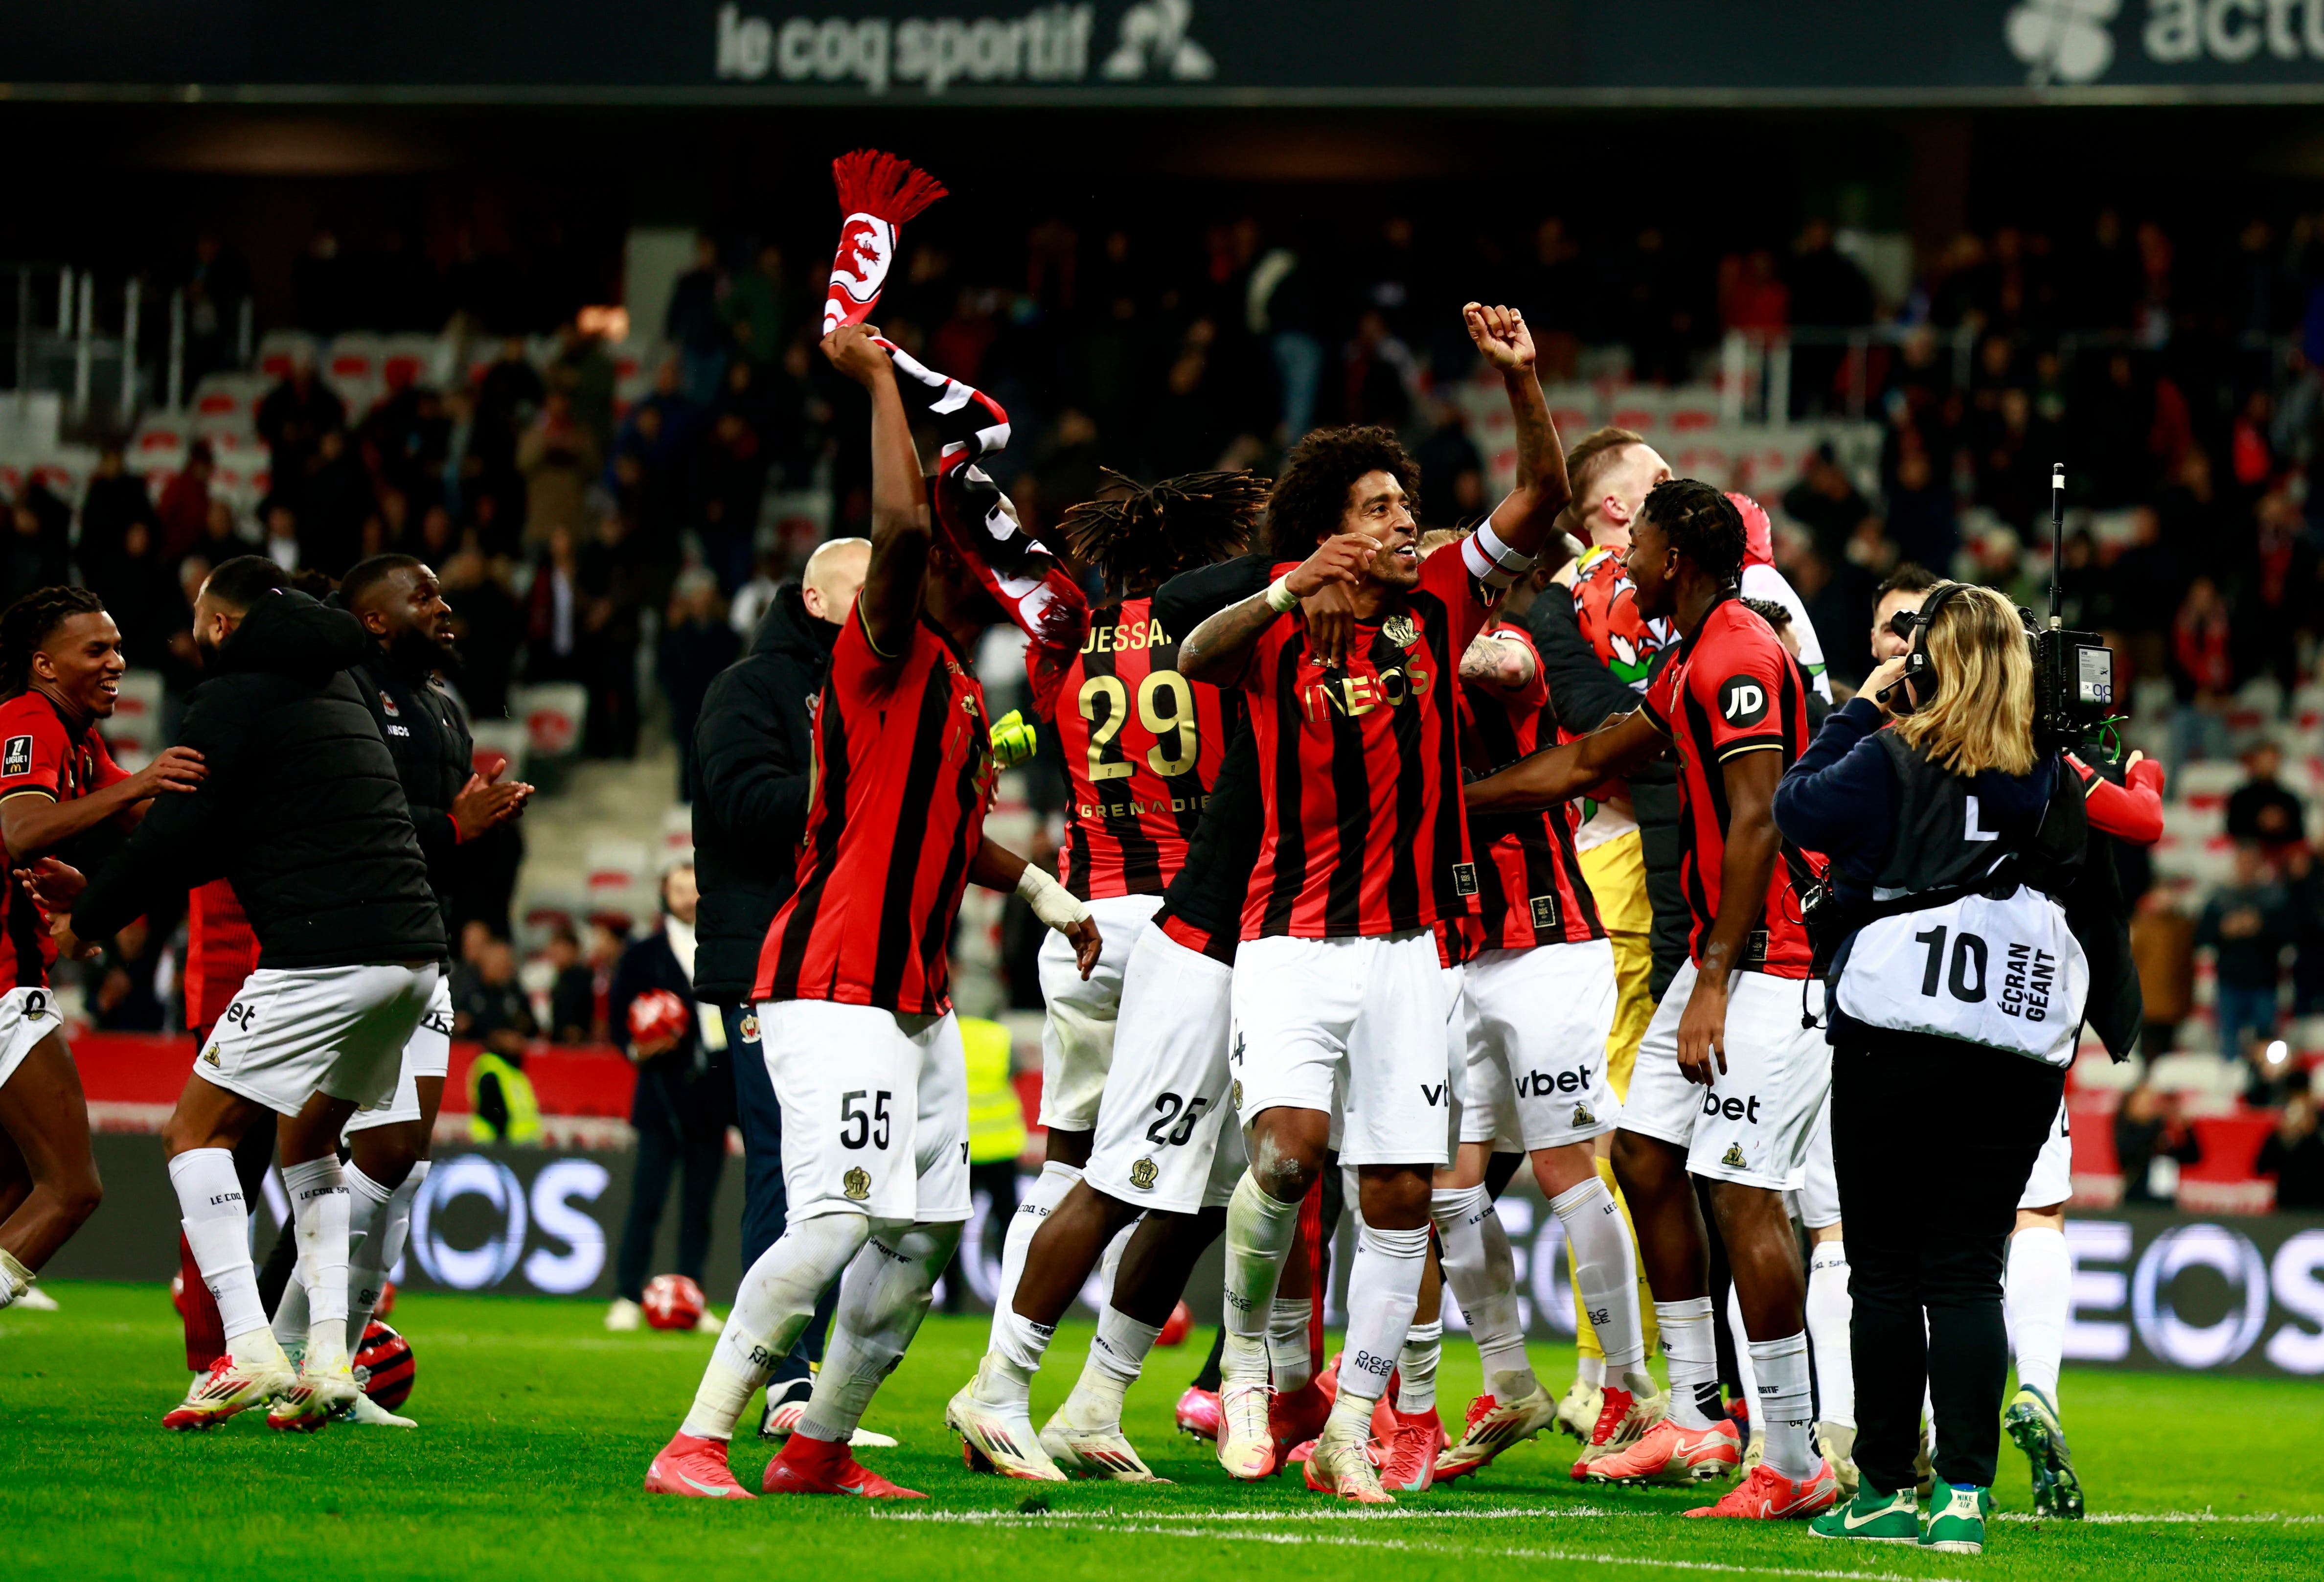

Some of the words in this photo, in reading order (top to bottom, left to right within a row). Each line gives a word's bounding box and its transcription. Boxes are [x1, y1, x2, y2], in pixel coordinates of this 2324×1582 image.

[717, 5, 772, 79] le
[777, 16, 890, 95] coq
[895, 4, 1091, 95] sportif
[1304, 654, 1430, 723] INEOS
[1726, 685, 1763, 720] JD
[1079, 670, 1197, 781] 29
[6, 755, 24, 764] LIGUE
[1915, 925, 1988, 1003] 10
[1997, 942, 2031, 1017] ÉCRAN
[2020, 949, 2055, 1023] GÉANT
[228, 1002, 255, 1032] et
[1516, 1065, 1592, 1099] vbet
[840, 1090, 891, 1150] 55
[1145, 1092, 1208, 1146] 25
[1703, 1086, 1760, 1124] bet
[210, 1194, 223, 1205] LE
[225, 1192, 242, 1202] COQ
[300, 1191, 310, 1200] LE
[312, 1187, 334, 1197] COQ
[410, 1152, 610, 1294] OS
[1354, 1357, 1389, 1376] NICE
[1358, 1350, 1393, 1369] OGC
[1902, 1489, 1914, 1497] NIKE
